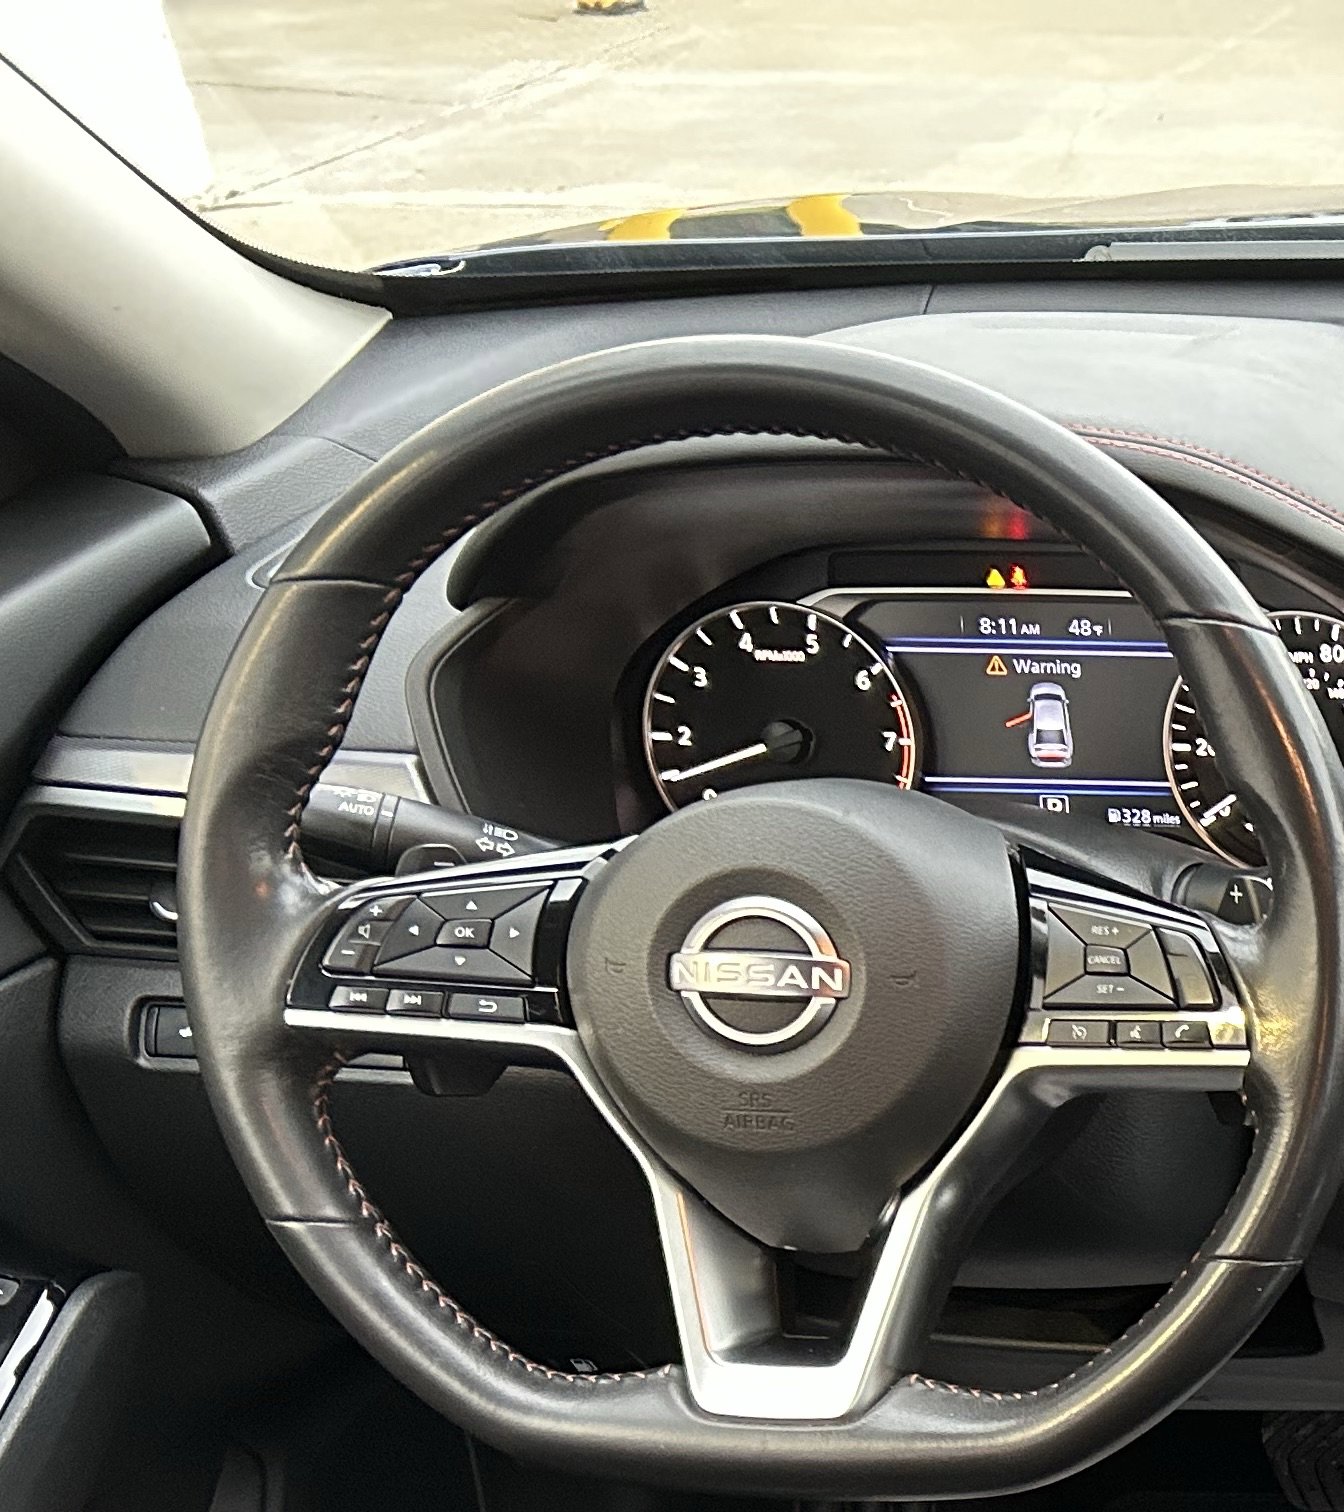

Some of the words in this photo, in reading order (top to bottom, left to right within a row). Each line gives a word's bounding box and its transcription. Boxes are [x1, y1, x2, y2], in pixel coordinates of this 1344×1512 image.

[979, 618, 1017, 635] 8:11
[1021, 624, 1040, 635] AM
[739, 632, 753, 653] 4
[806, 635, 820, 654] 5
[1319, 643, 1344, 663] 80
[693, 666, 708, 687] 3
[1013, 658, 1082, 678] Warning
[855, 669, 870, 690] 6
[677, 726, 692, 746] 2
[881, 731, 897, 751] 7
[338, 802, 375, 817] AUTO
[1122, 808, 1151, 824] 328
[1152, 812, 1181, 825] miles
[454, 926, 475, 938] OK
[1091, 925, 1110, 935] RES
[1087, 955, 1122, 966] CANCEL
[673, 960, 845, 991] NISSAN
[1096, 984, 1114, 994] SET
[738, 1092, 774, 1108] SRS
[723, 1115, 796, 1131] AIRBAG
